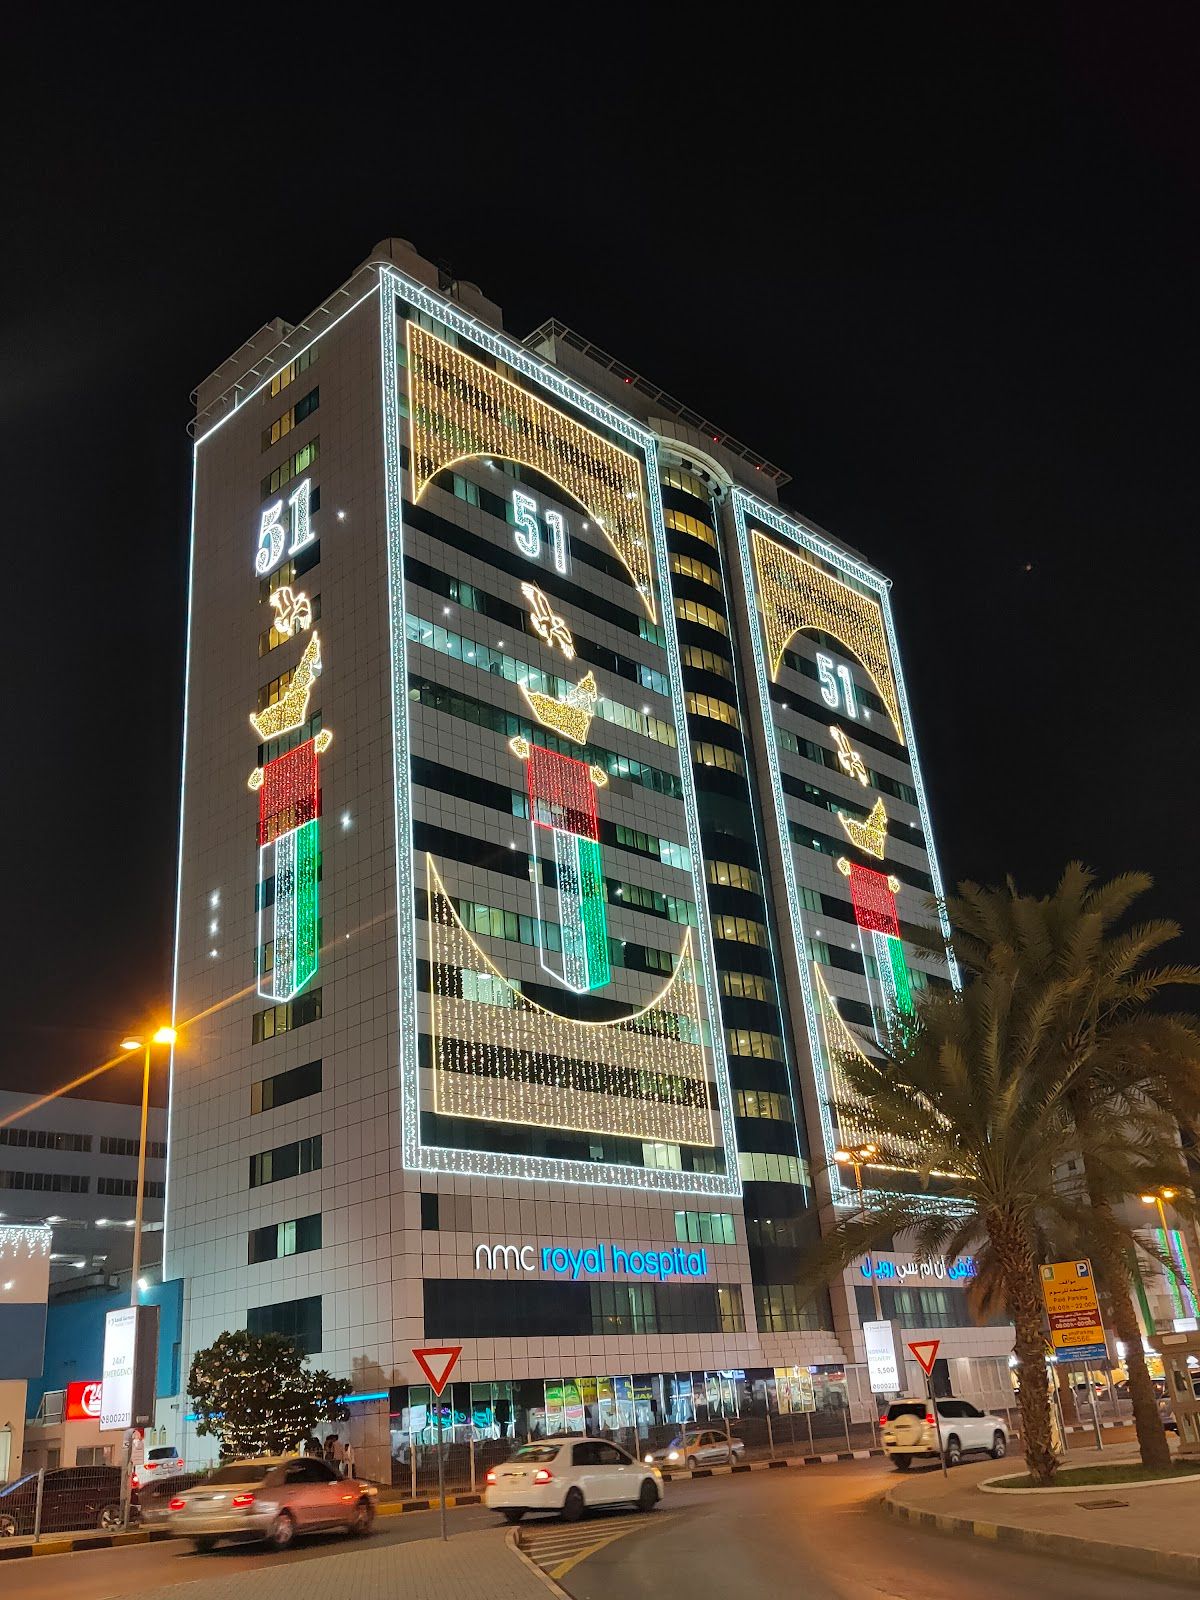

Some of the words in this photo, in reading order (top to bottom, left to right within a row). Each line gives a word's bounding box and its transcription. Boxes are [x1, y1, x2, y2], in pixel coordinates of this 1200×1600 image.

[255, 478, 315, 574] 51
[512, 489, 567, 574] 51
[816, 652, 857, 718] 51
[475, 1244, 535, 1271] nmc
[541, 1244, 606, 1279] royal
[611, 1244, 707, 1280] hospital
[1077, 1263, 1087, 1277] P
[877, 1366, 895, 1374] 5,500
